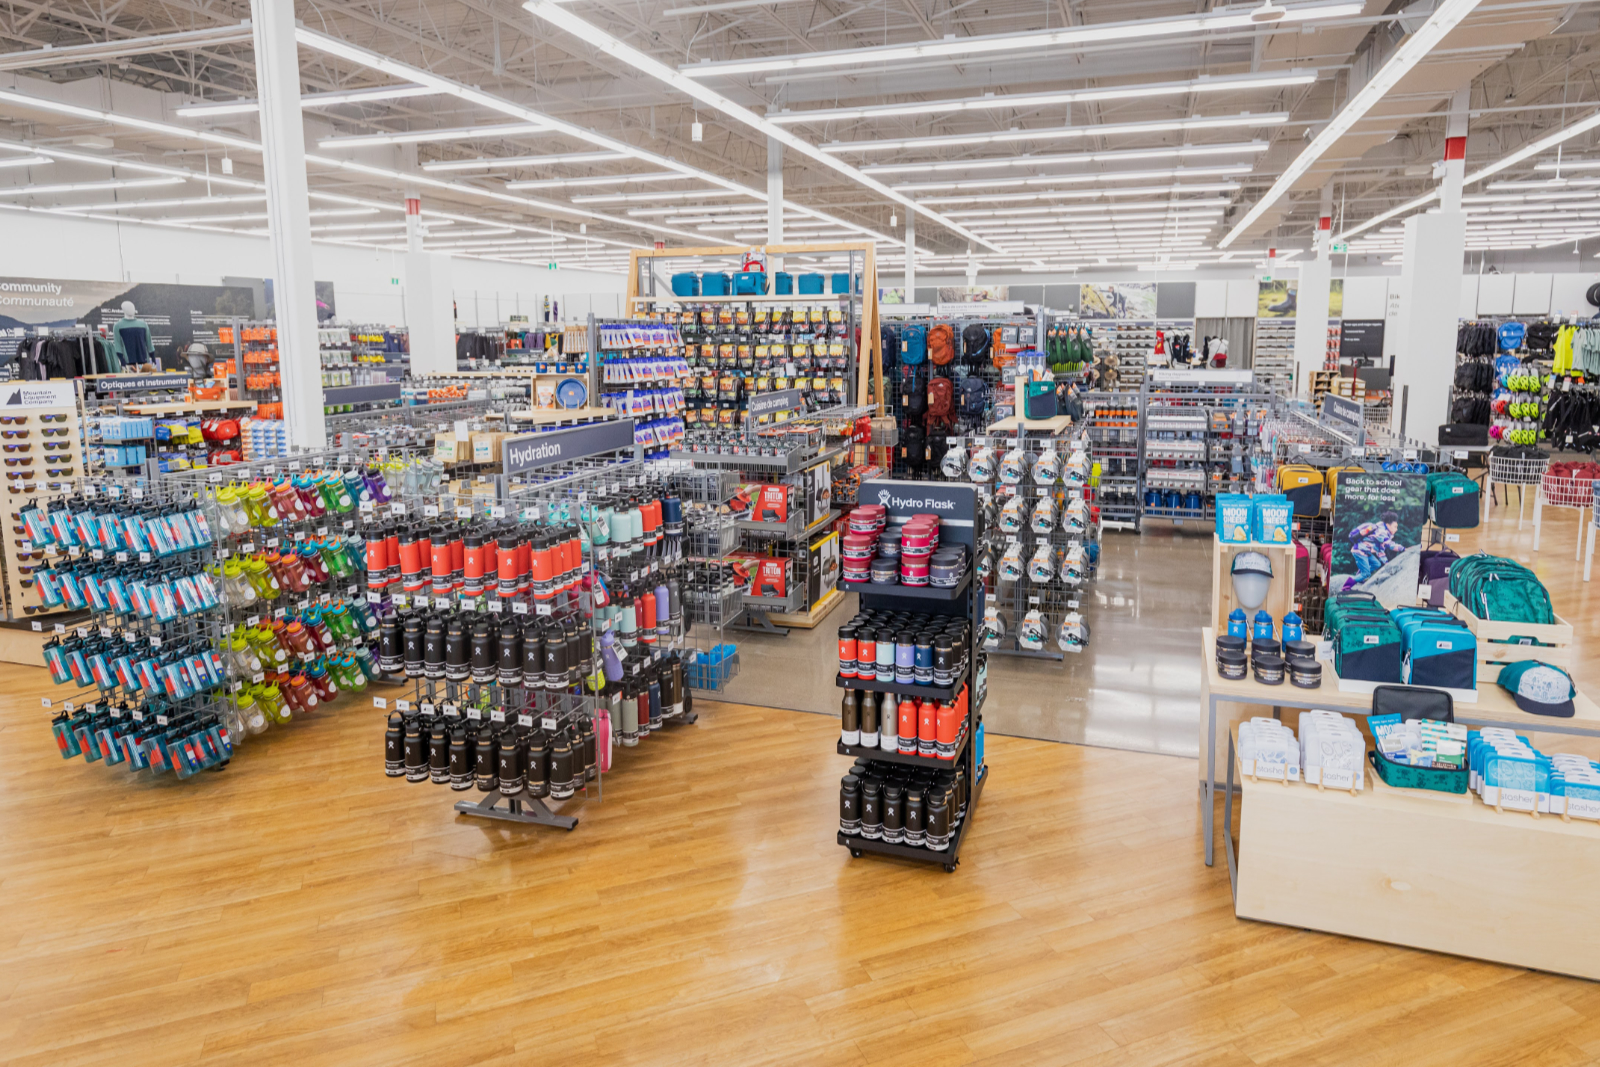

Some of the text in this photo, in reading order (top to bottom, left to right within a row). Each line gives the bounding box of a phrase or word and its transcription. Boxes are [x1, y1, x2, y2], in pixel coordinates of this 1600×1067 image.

[0, 282, 62, 295] ommunity
[100, 380, 136, 390] Optiques
[146, 378, 186, 386] instruments
[510, 442, 562, 467] Hydration
[1376, 478, 1402, 486] school
[764, 491, 783, 500] TRITON
[892, 496, 954, 510] Hydro Flask
[1222, 508, 1248, 517] MOON
[1262, 508, 1288, 518] MOON
[762, 566, 782, 575] TRITON
[1376, 724, 1395, 737] MOO
[1500, 794, 1534, 804] stasher
